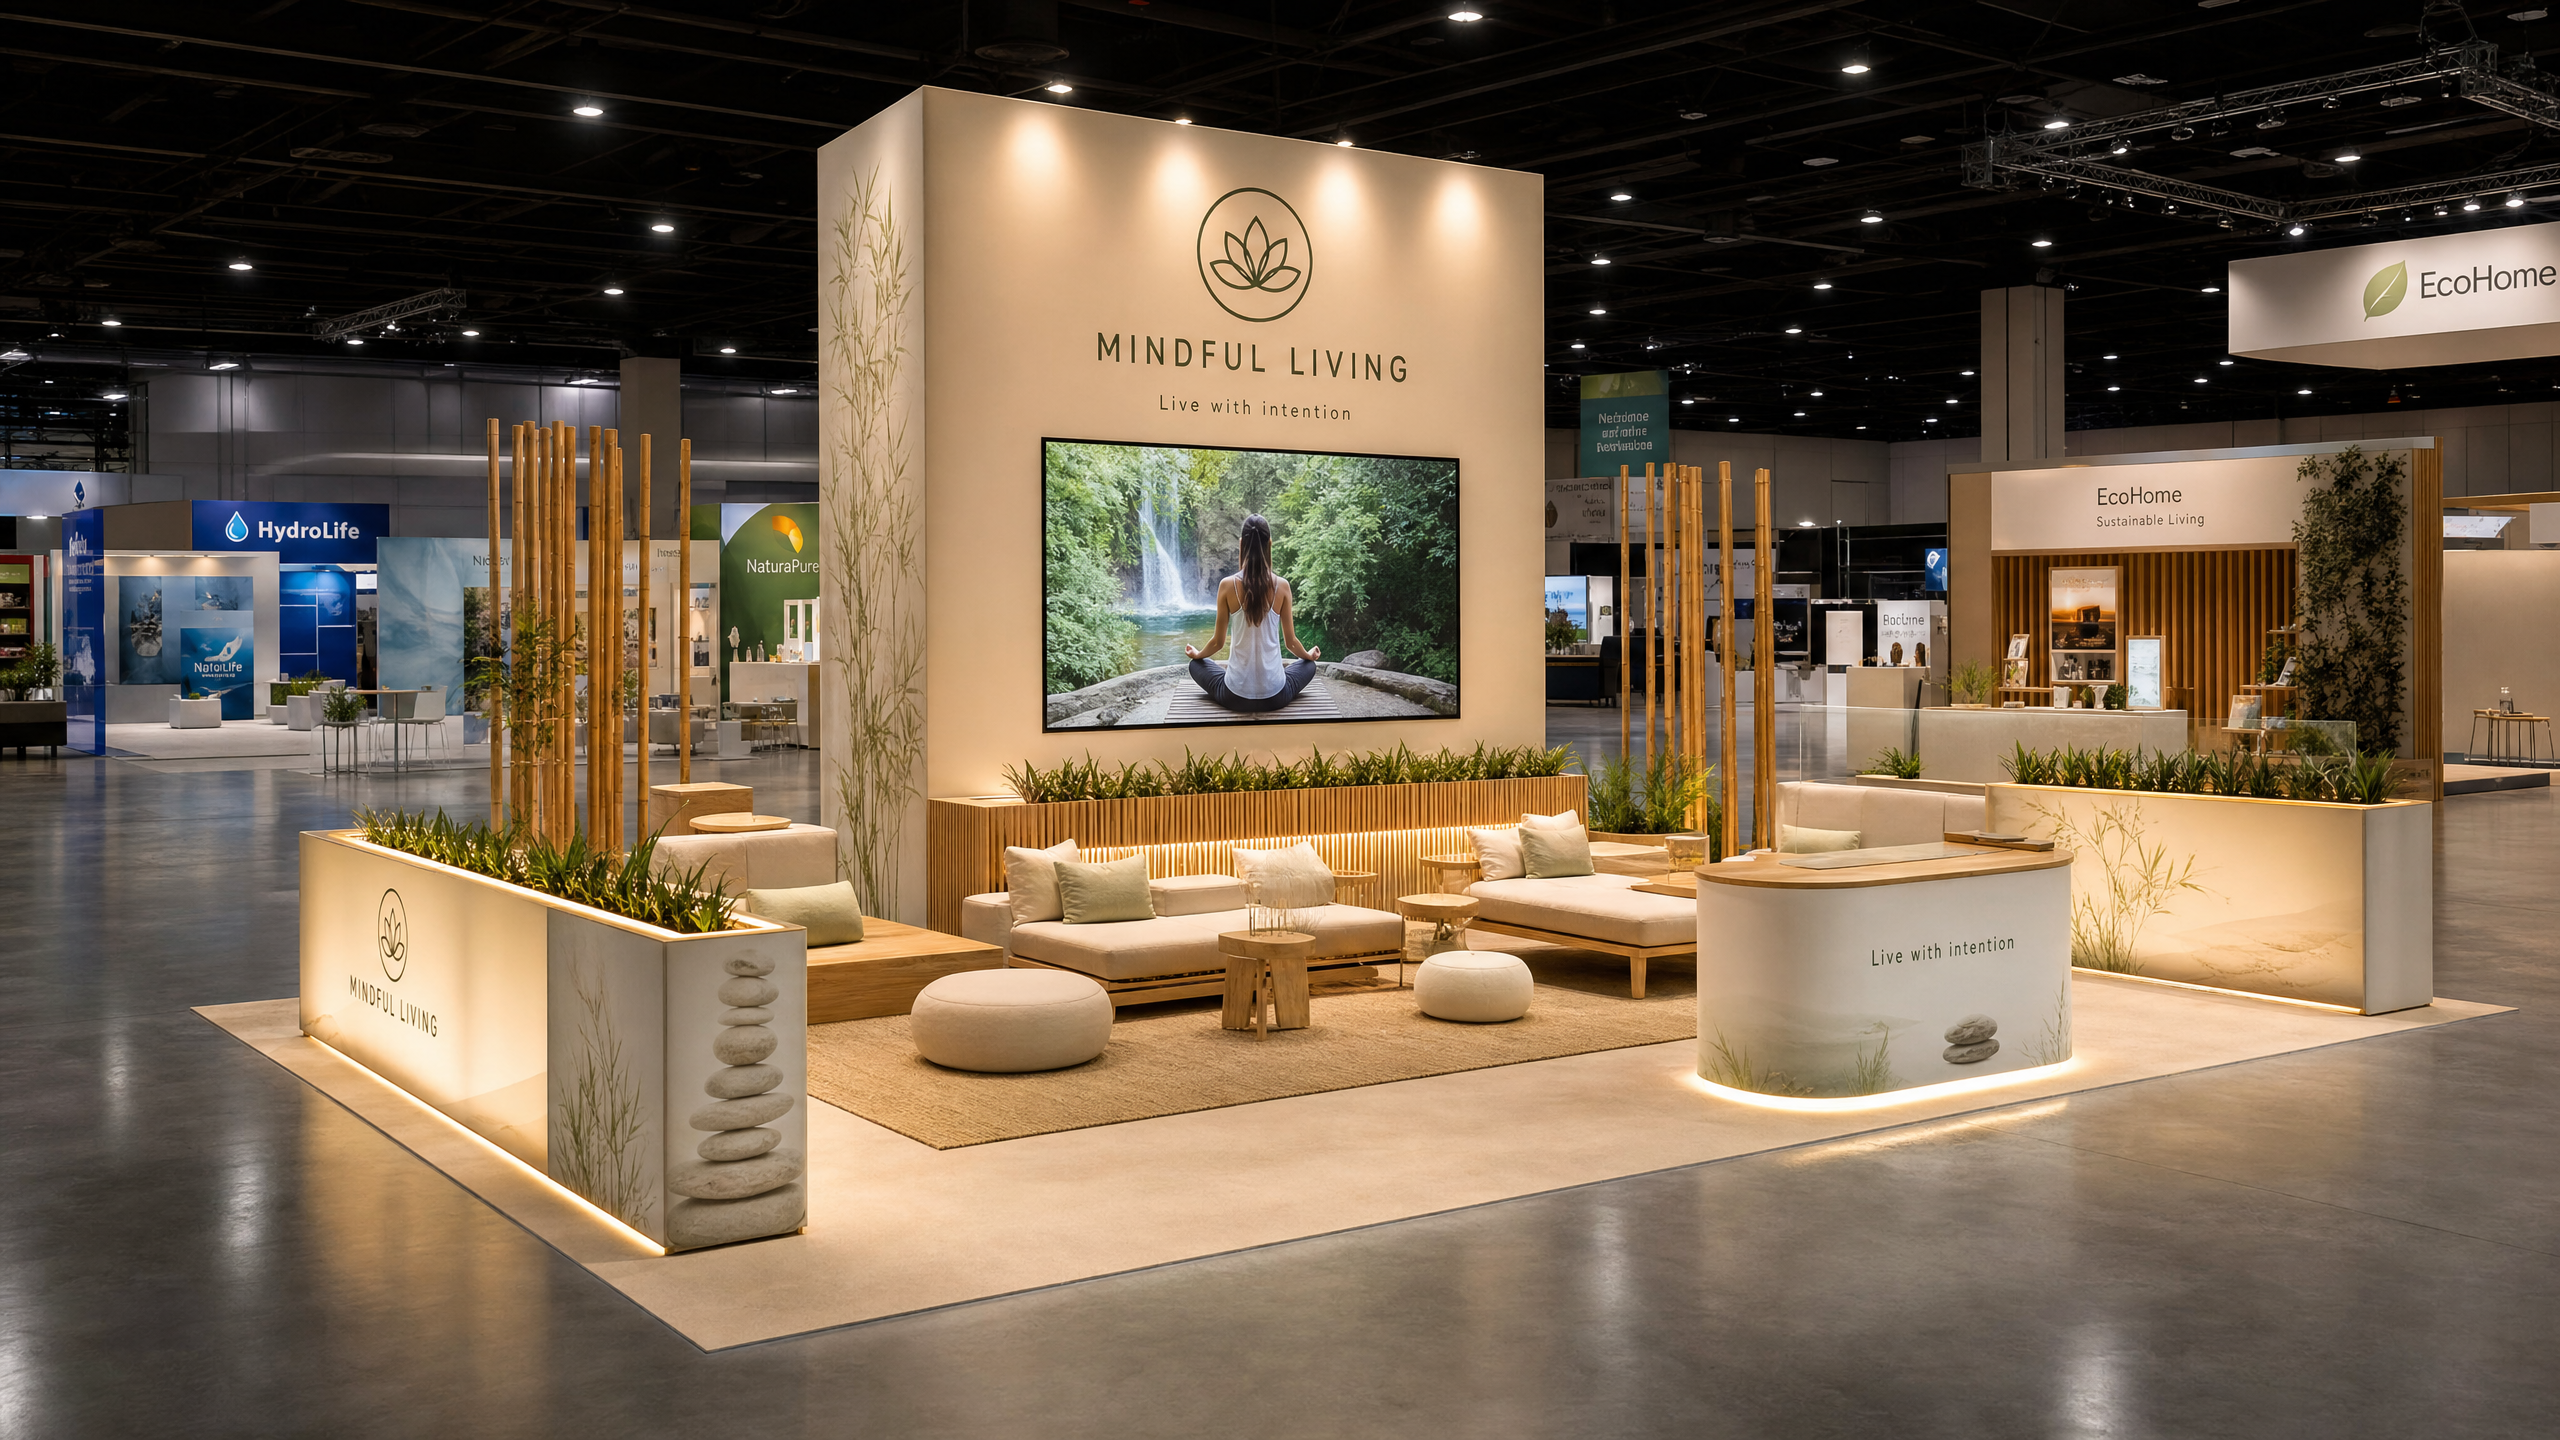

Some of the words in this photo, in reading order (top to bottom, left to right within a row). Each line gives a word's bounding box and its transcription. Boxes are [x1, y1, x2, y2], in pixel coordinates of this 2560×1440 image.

[2420, 264, 2557, 299] EcoHome
[1097, 332, 1266, 373] MINDFUL
[1291, 347, 1407, 382] LIVING
[1159, 394, 1200, 412] Live
[1210, 399, 1251, 415] with
[1262, 401, 1351, 420] intention
[2097, 486, 2182, 506] EcoHome
[258, 521, 360, 543] HydroLife
[2096, 514, 2164, 527] Sustainable
[2168, 513, 2205, 527] Living
[746, 558, 819, 573] NaturaPure
[1871, 949, 1903, 967] Live
[1910, 943, 1942, 961] with
[1949, 936, 2014, 957] intention
[350, 974, 395, 1017] MINDFUL
[400, 999, 438, 1037] LIVING
